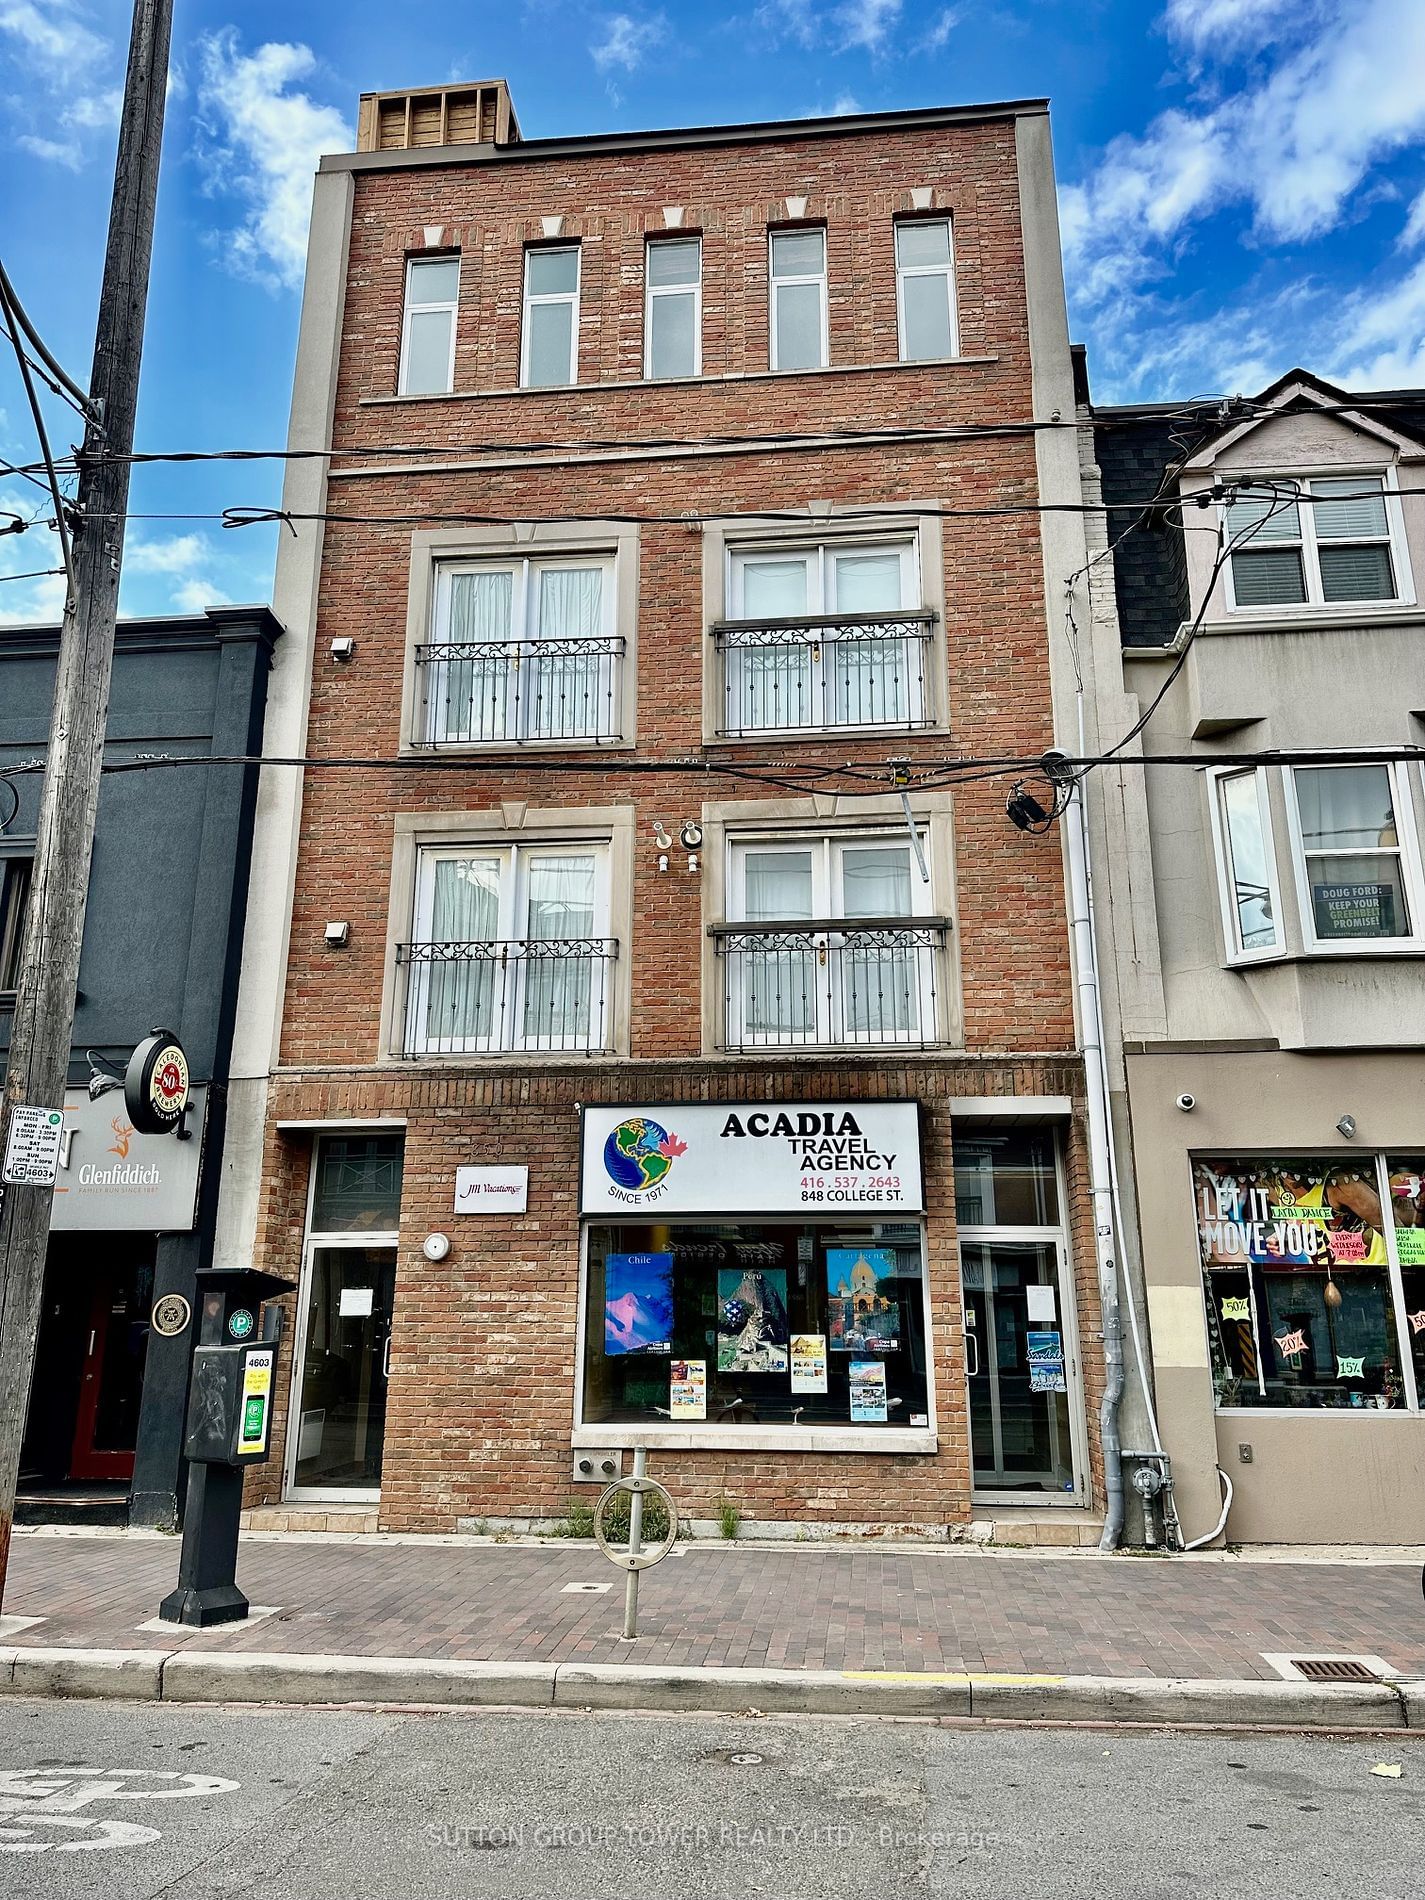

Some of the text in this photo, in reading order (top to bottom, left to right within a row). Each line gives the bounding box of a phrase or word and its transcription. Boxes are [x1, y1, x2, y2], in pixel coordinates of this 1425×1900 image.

[1322, 886, 1383, 899] DOUG FORD:
[1328, 898, 1380, 911] KEEP YOUR
[1330, 907, 1381, 920] GREENBELT
[1333, 916, 1380, 929] PROMISE!
[156, 1053, 185, 1086] CALEDONIAN
[156, 1086, 181, 1108] BREWERY
[165, 1110, 181, 1121] HERE
[718, 1111, 863, 1138] ACADIA
[788, 1138, 877, 1154] TRAVEL
[799, 1153, 898, 1171] AGENCY
[26, 1168, 49, 1178] 4603
[78, 1163, 161, 1186] Glenfiddich
[483, 1183, 520, 1195] Vacations
[607, 1183, 669, 1205] SINCE 1971
[801, 1189, 904, 1201] 848 COLLEGE ST.
[1203, 1186, 1270, 1221] LET IT
[1273, 1208, 1332, 1218] LATIN DANCE
[1204, 1222, 1318, 1256] MOVE YOU
[627, 1255, 652, 1265] Chile
[743, 1271, 762, 1281] Perú
[1226, 1302, 1247, 1312] 50%
[1281, 1336, 1304, 1352] 20%
[248, 1358, 270, 1368] 4603
[1339, 1360, 1362, 1375] 15%
